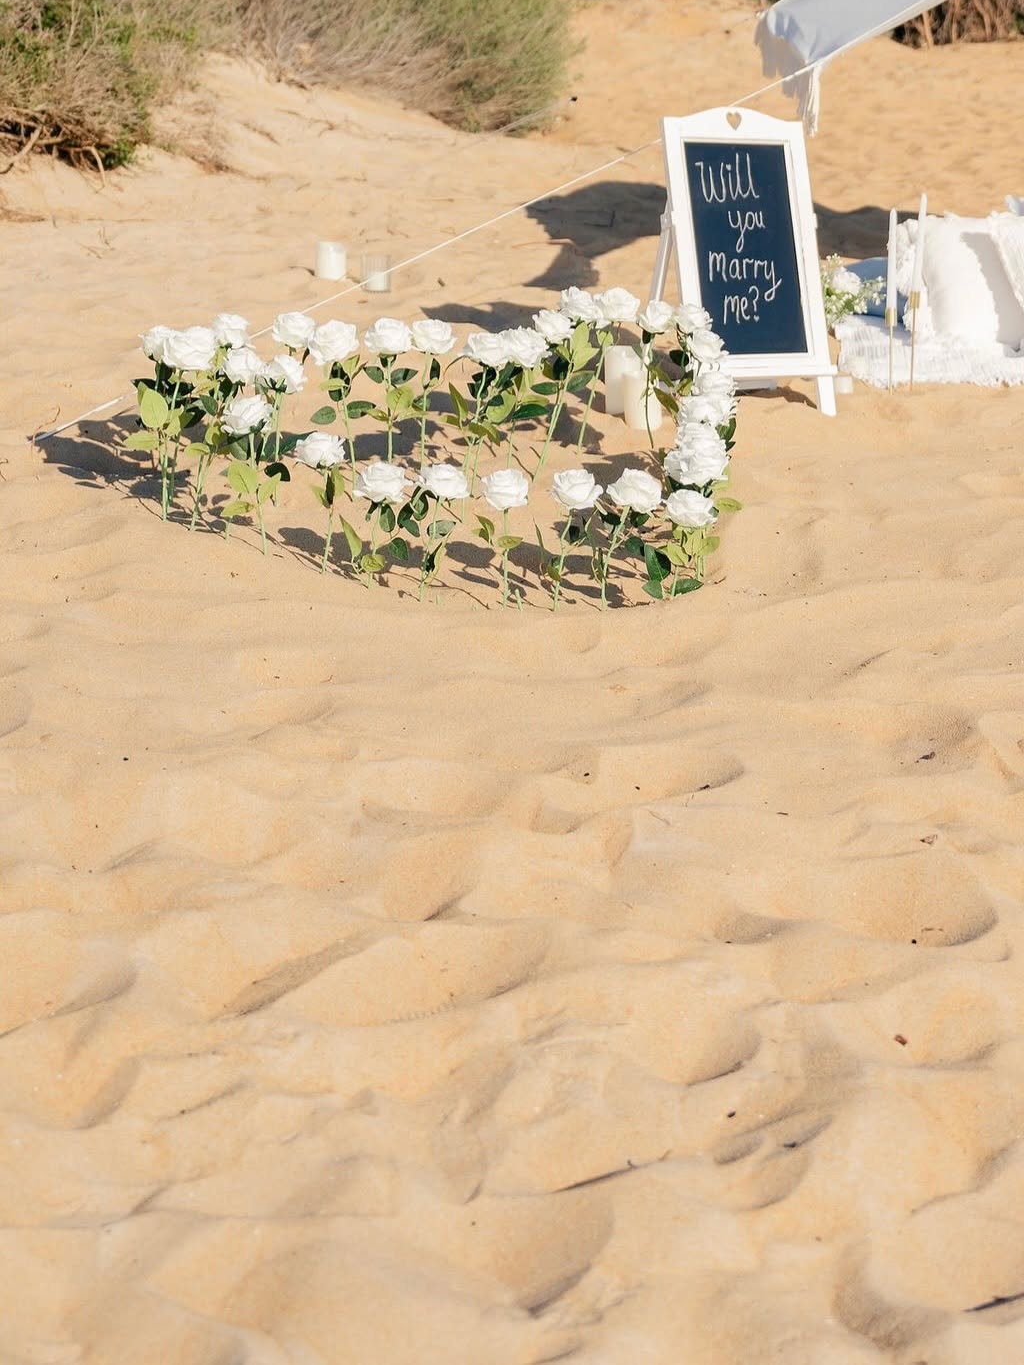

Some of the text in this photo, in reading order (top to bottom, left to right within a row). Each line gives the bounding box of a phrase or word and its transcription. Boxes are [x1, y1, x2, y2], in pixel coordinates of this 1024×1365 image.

[694, 152, 760, 204] Will
[728, 209, 766, 254] you
[723, 285, 760, 325] me?
